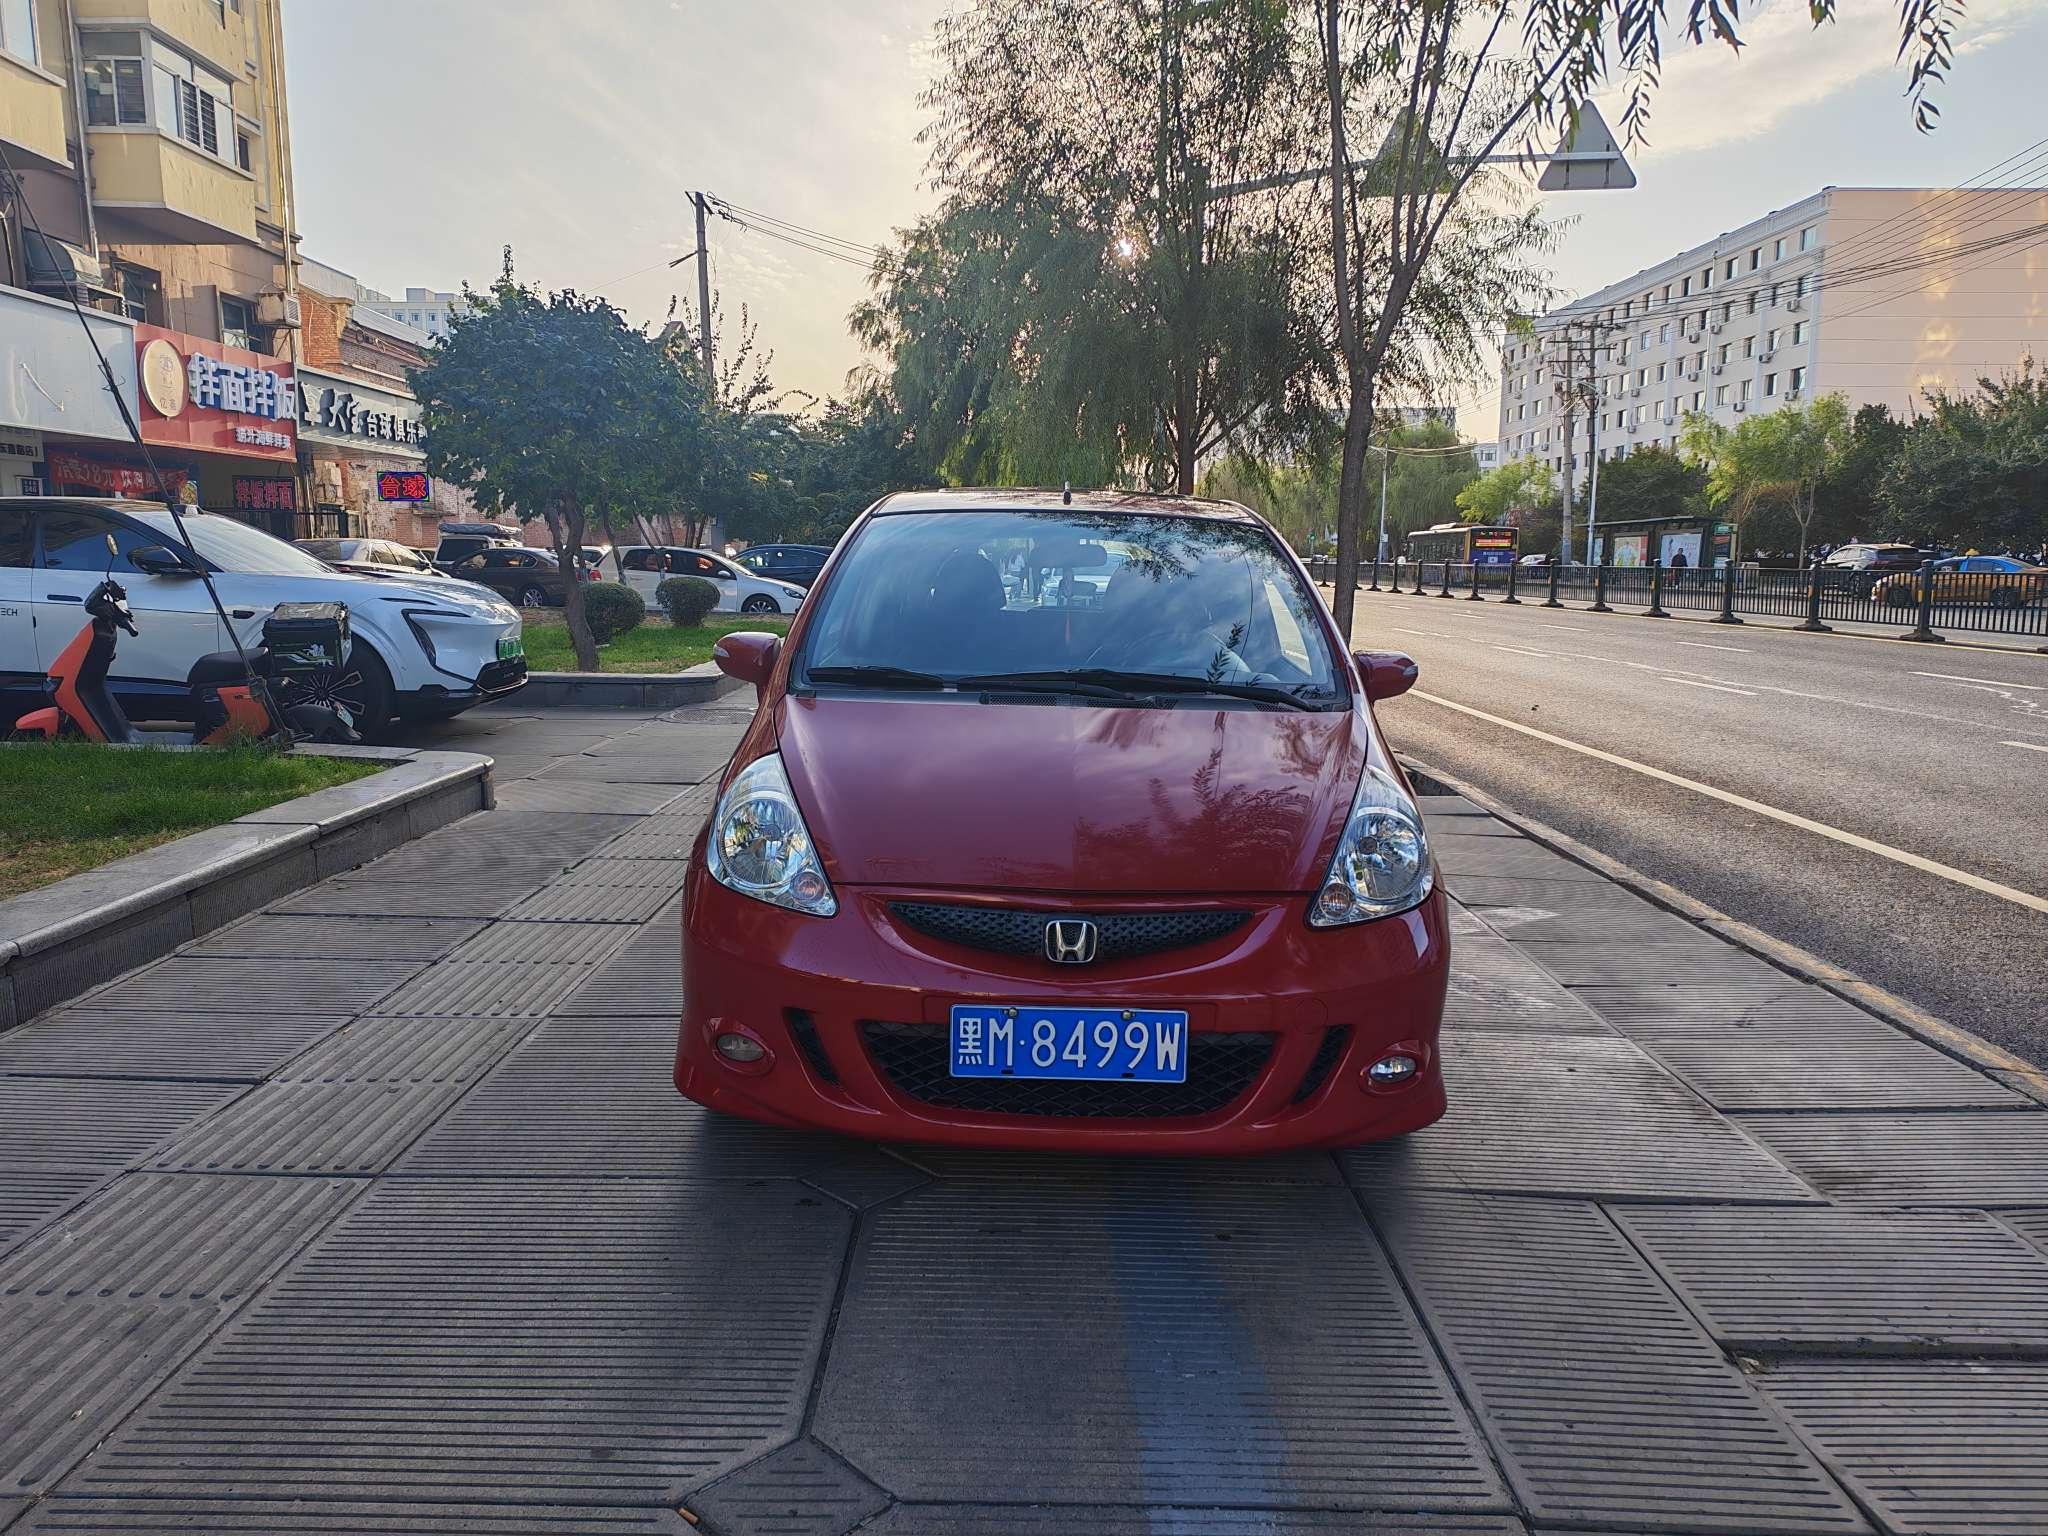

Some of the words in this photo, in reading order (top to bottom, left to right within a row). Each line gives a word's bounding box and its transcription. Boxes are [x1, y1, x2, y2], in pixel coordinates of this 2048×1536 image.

[188, 352, 296, 421] 拌面拌饭
[381, 474, 426, 498] 台球
